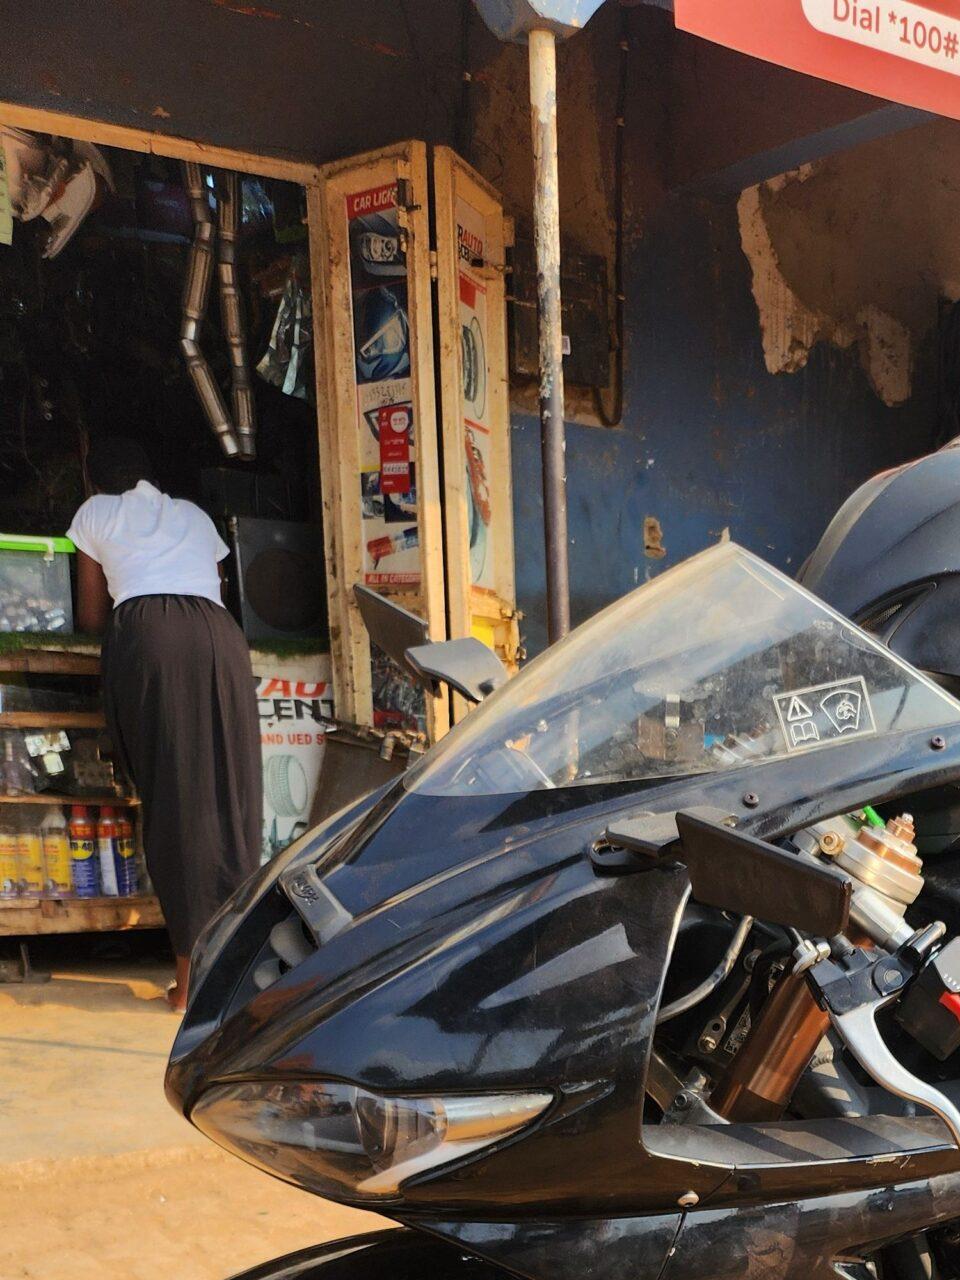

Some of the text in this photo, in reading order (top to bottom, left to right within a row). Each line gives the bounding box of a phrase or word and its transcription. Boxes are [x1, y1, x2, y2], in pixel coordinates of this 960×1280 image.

[833, 0, 880, 34] Dial
[353, 195, 372, 212] CAR
[287, 733, 313, 745] UED
